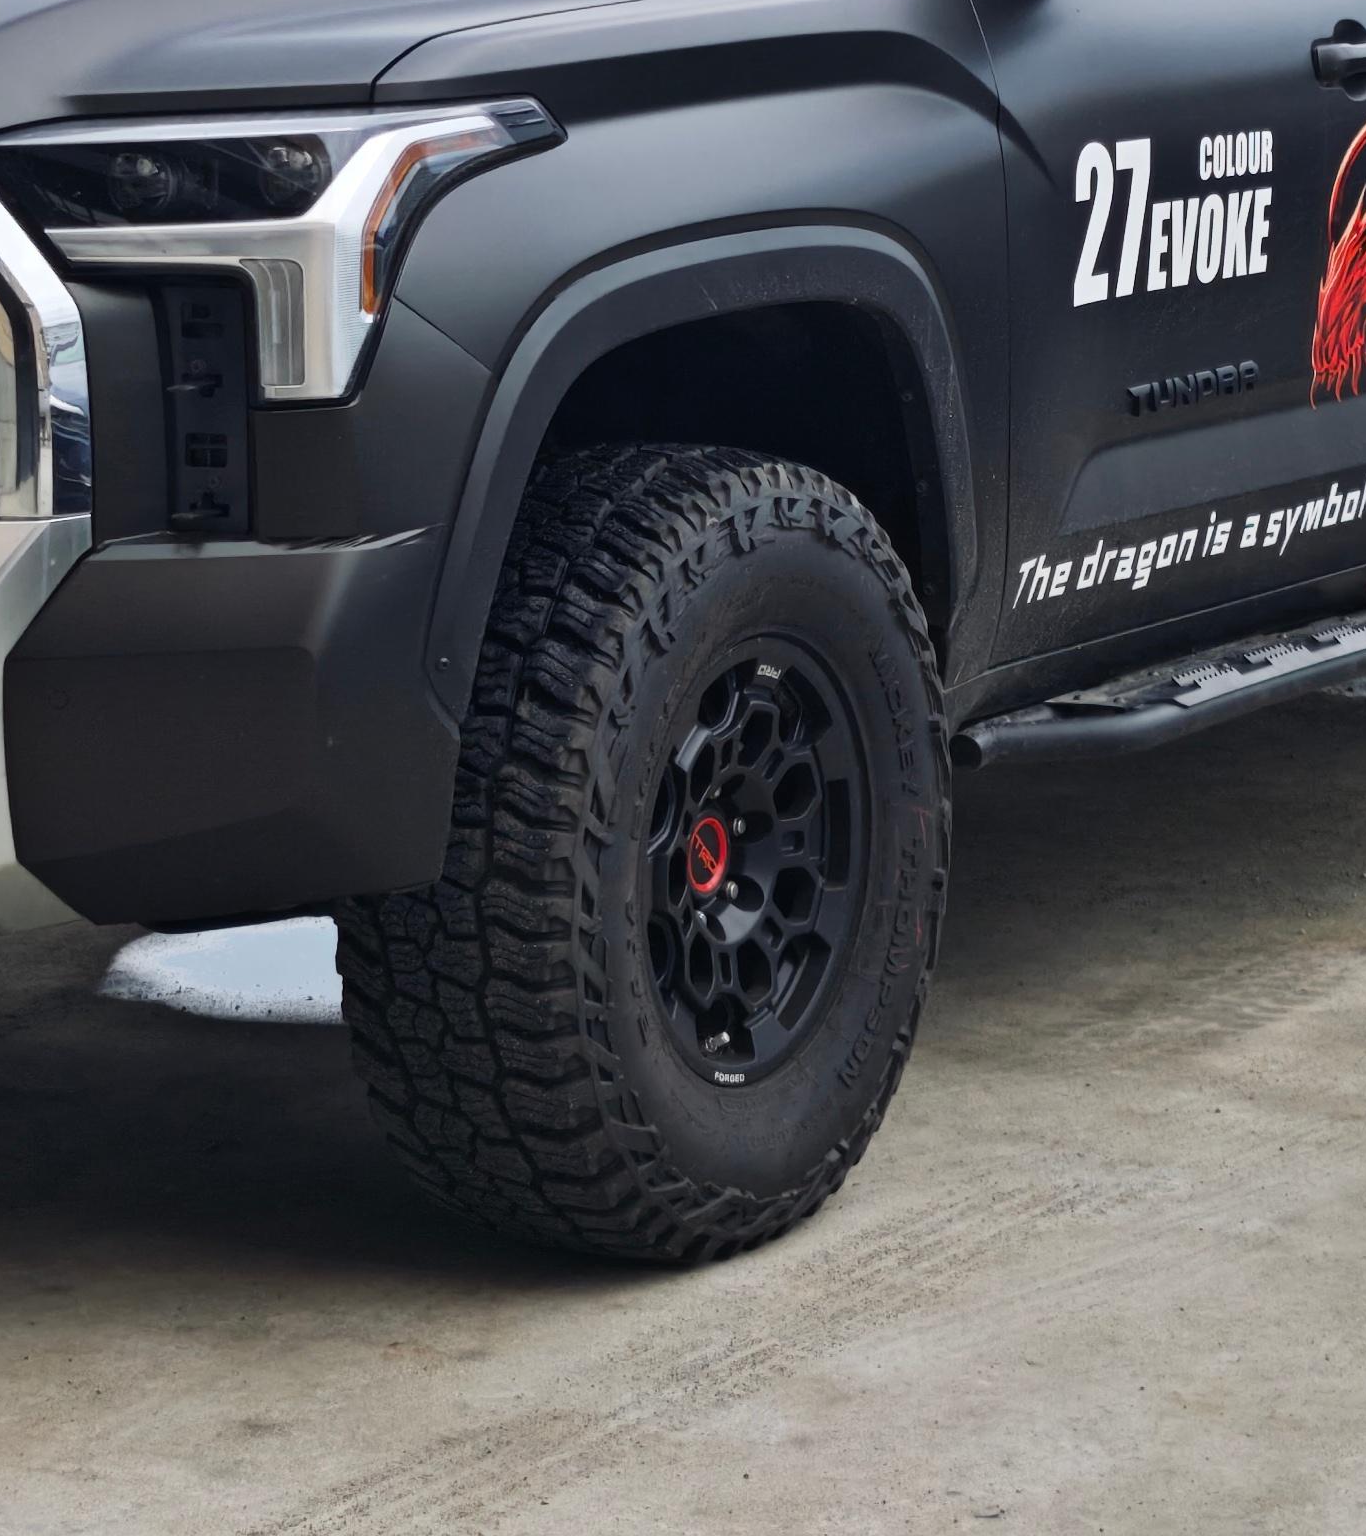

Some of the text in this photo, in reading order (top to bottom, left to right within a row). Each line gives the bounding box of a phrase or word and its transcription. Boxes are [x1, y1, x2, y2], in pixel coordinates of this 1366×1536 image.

[1199, 130, 1273, 181] COLOUR
[1073, 138, 1151, 307] 27
[1146, 186, 1273, 292] EVOKE
[1126, 360, 1260, 417] TUNDRA
[1013, 554, 1073, 609] The
[1076, 528, 1198, 590] dragon
[1202, 511, 1233, 558] is
[1239, 514, 1261, 548] a
[691, 833, 718, 875] TRD
[714, 1071, 746, 1083] FORGED
